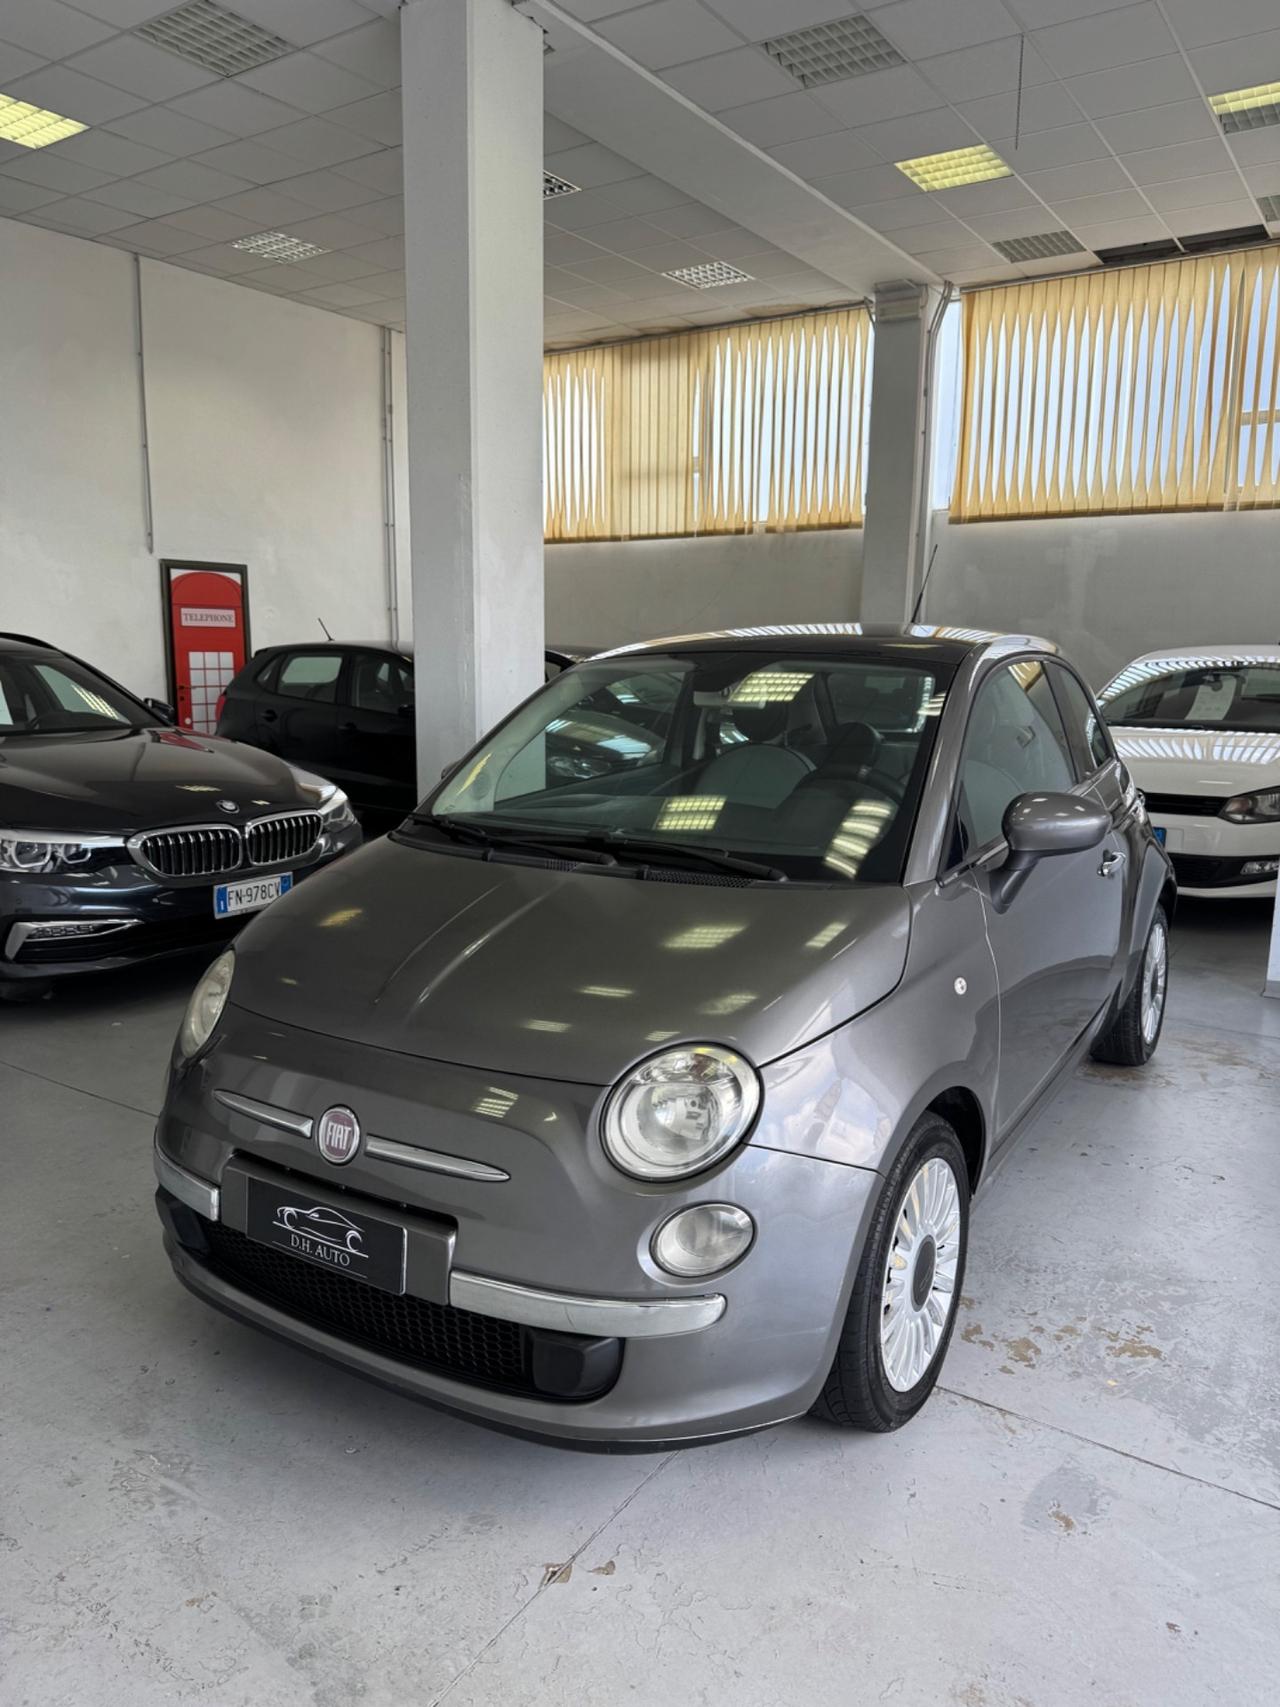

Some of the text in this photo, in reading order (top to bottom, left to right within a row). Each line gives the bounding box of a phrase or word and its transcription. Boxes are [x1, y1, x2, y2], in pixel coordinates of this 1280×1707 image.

[183, 612, 234, 624] TELEPHONE
[326, 1121, 352, 1150] FIAT
[290, 1234, 350, 1266] D.H. AUTO
